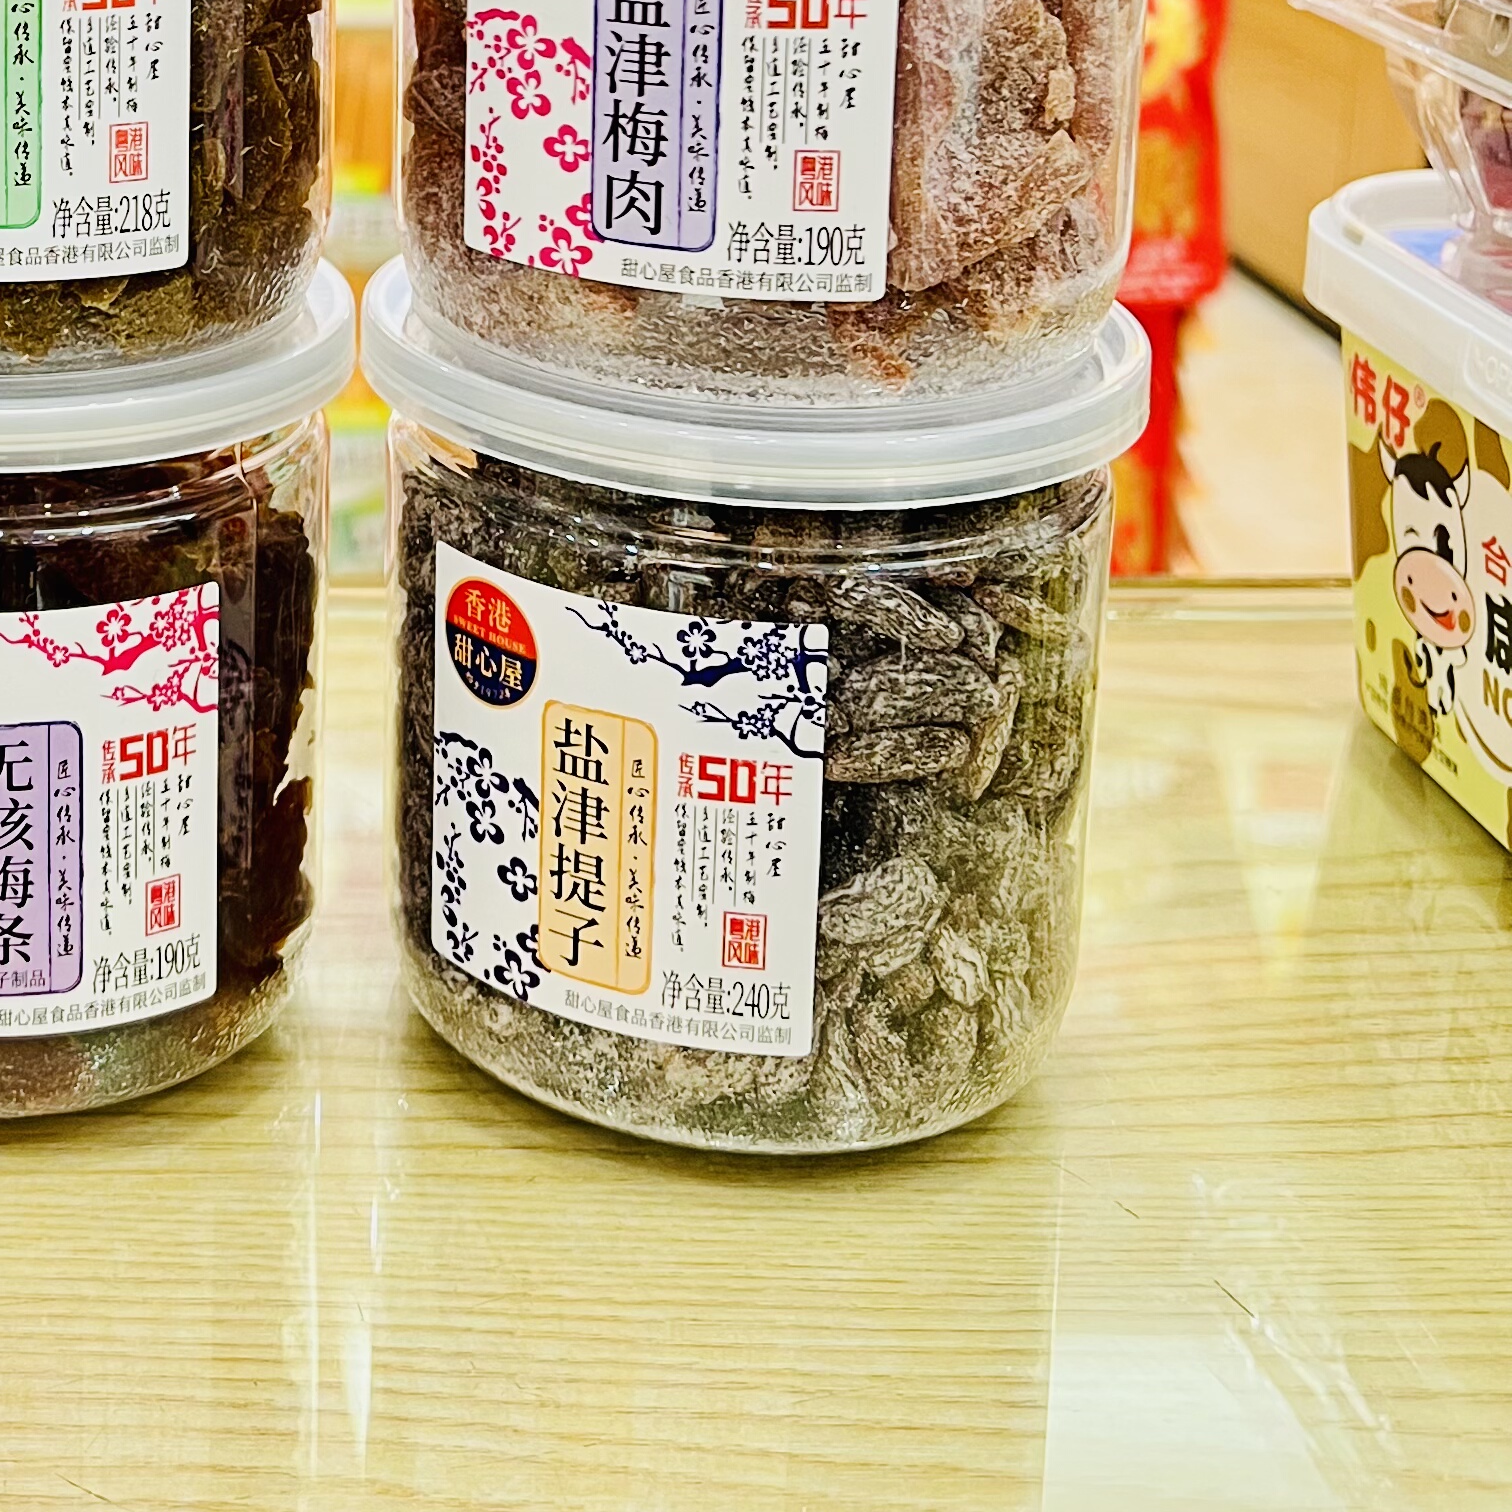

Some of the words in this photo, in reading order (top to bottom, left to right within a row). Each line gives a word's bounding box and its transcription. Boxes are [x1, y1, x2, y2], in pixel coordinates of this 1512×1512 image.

[620, 256, 873, 295] 甜心屋食品香港有限公司监制
[1351, 352, 1411, 449] 伟仔
[452, 612, 486, 640] SWEET
[488, 628, 527, 657] HOUSE
[463, 587, 513, 636] 香港
[452, 631, 525, 693] 甜心屋
[548, 716, 611, 969] 盐津提子
[563, 988, 792, 1047] 甜心屋食品香港有限公司监制
